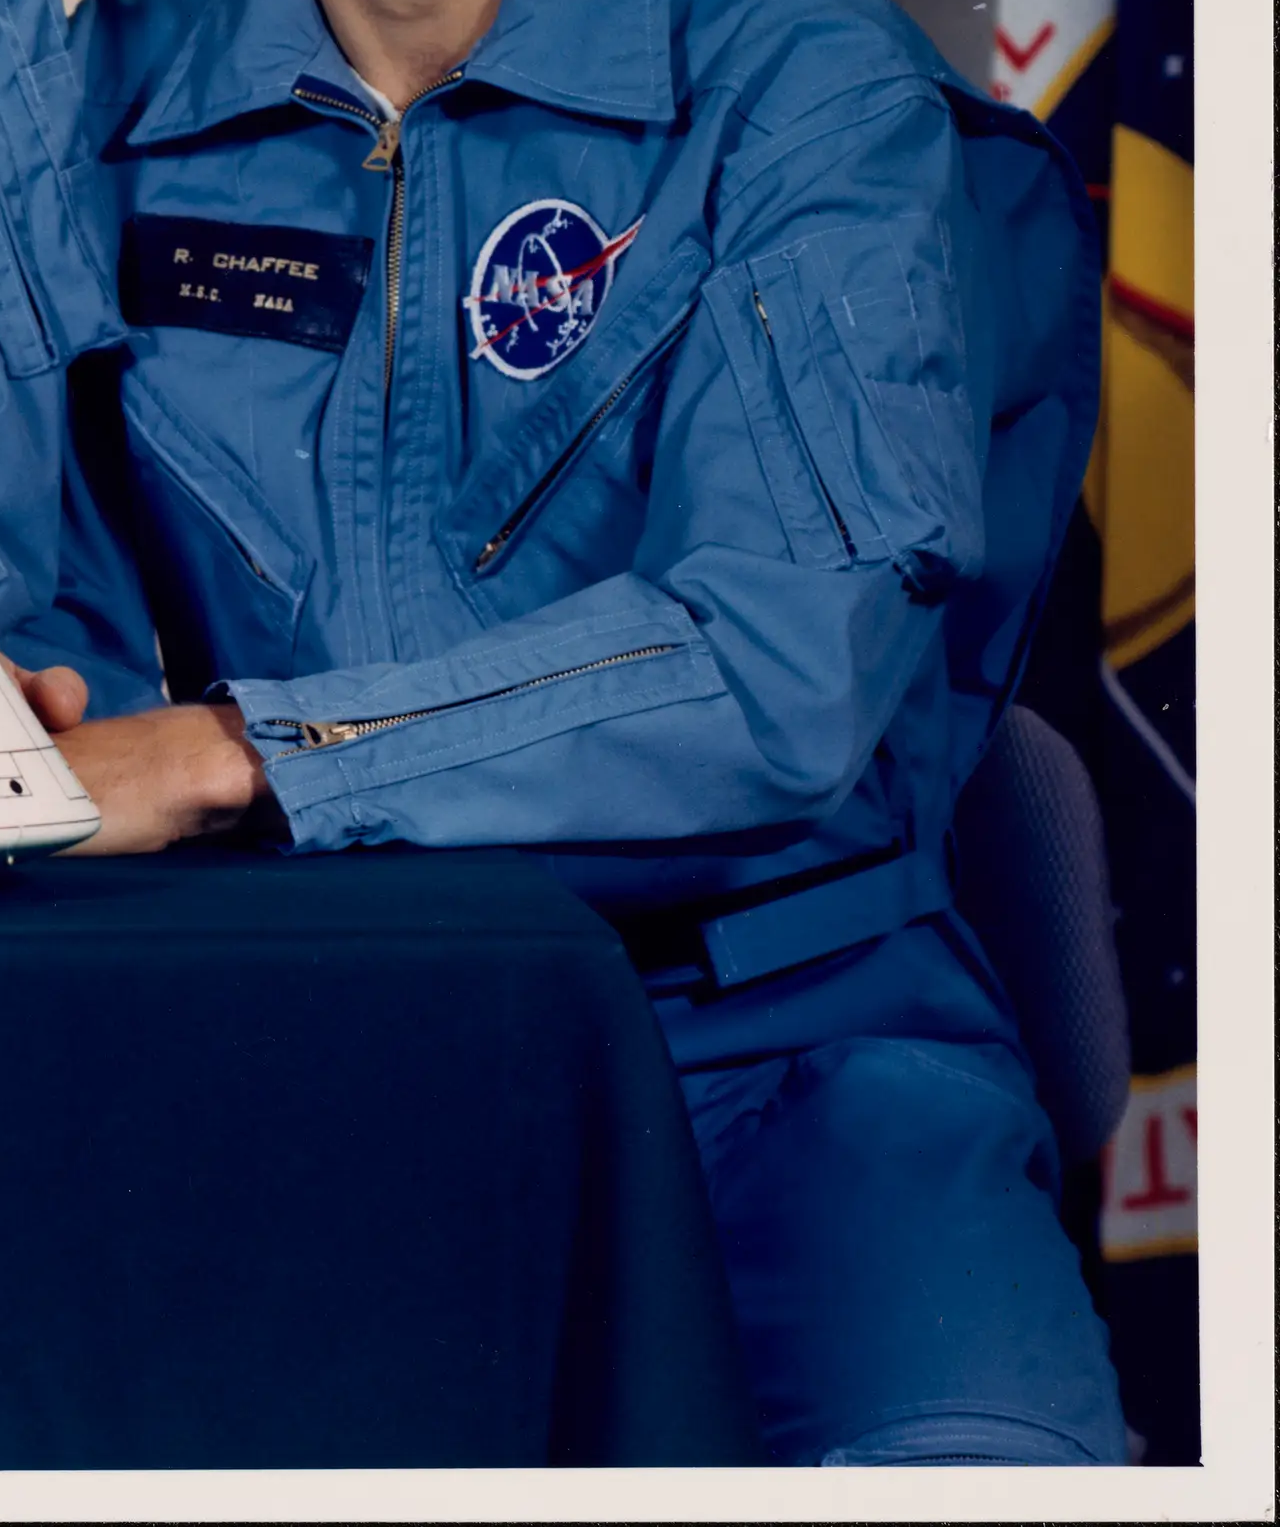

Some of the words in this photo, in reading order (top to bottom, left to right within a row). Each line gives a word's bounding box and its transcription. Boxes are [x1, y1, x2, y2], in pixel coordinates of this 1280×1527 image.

[173, 247, 194, 264] R.
[212, 253, 320, 281] CHAFFEE
[253, 294, 294, 312] NASA
[489, 266, 595, 316] NASA
